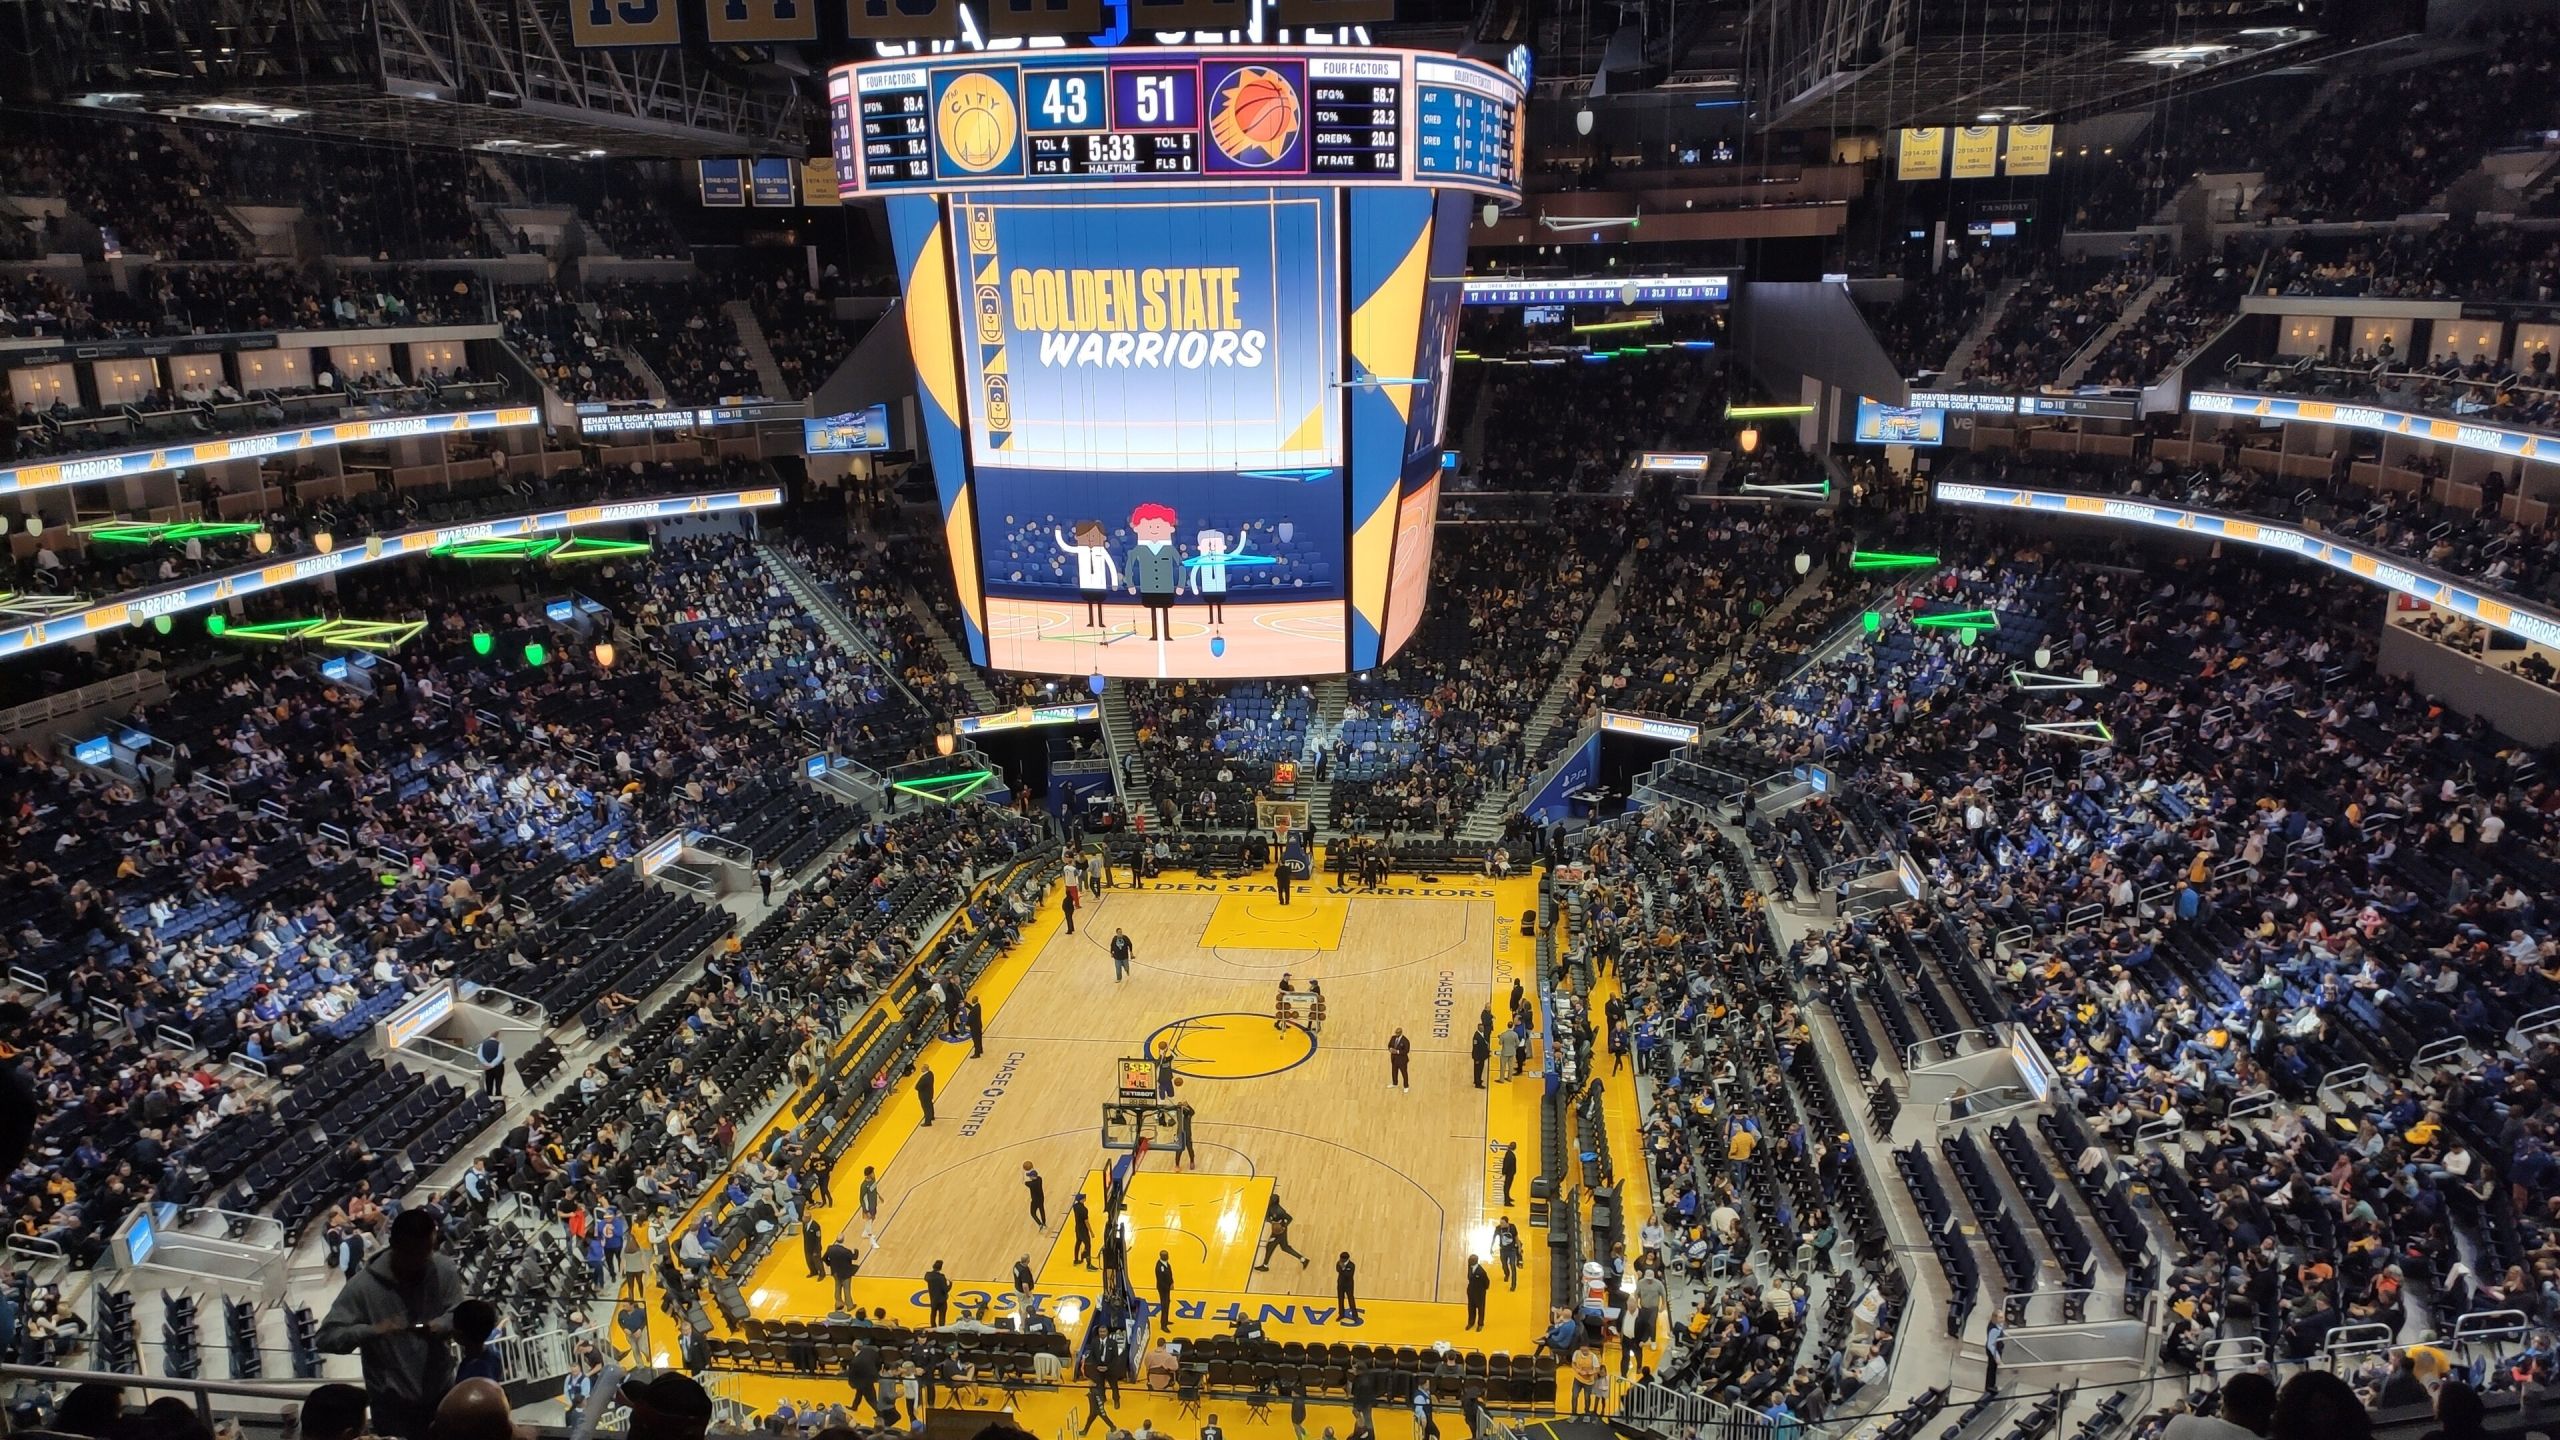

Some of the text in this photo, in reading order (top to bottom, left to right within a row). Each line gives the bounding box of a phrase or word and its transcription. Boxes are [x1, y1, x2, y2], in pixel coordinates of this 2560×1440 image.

[1323, 62, 1389, 76] FOUR FACTORS
[866, 73, 917, 88] FOUR FACTORS
[951, 92, 1000, 115] CITY
[1043, 77, 1087, 124] 43
[1137, 76, 1175, 121] 51
[1316, 90, 1344, 101] EFG%
[1424, 93, 1437, 103] AST
[1317, 109, 1395, 124] TO% 23.2
[866, 118, 926, 134] TO% 12.4
[908, 139, 927, 154] 15.4
[1036, 137, 1069, 151] TOL 4
[1155, 135, 1191, 149] TOL 5
[1317, 131, 1395, 147] OREB% 20.0
[1088, 134, 1135, 161] 5:33
[869, 161, 928, 176] FT RATE 12.8
[1037, 159, 1070, 173] FLS 0
[1088, 163, 1137, 174] HALFTIME
[1156, 156, 1191, 171] FLS 0
[1317, 153, 1395, 168] FT RATE 17.5
[1981, 203, 2030, 212] TANDUAY
[1010, 267, 1242, 332] GOLDEN STATE
[1471, 292, 1479, 301] 17
[1491, 292, 1497, 301] 4
[1588, 290, 1594, 299] 2
[1605, 290, 1615, 298] 24
[1039, 329, 1267, 370] WARRIORS
[1911, 393, 1949, 401] BEHAVIOR
[1949, 394, 1968, 402] SUCH
[1979, 395, 2004, 404] TRYING
[1911, 400, 1935, 408] ENTER
[1951, 402, 1976, 411] COURT,
[1977, 404, 2014, 412] THROWING
[582, 415, 621, 426] BEHAVIOR
[622, 414, 642, 423] SUCH
[644, 413, 654, 422] AS
[654, 412, 683, 421] TRYING
[683, 411, 693, 419] TO
[2335, 406, 2384, 427] WARRIORS
[370, 418, 428, 435] WARRIORS
[583, 418, 693, 433] ENTER THE COURT, THROWING
[2457, 427, 2502, 448] WARRIORS
[229, 436, 278, 456] WARRIORS
[61, 458, 123, 481] WARRIORS
[601, 503, 660, 520] WARRIORS
[2105, 502, 2156, 521] WARRIORS
[437, 524, 493, 544] WARRIORS
[2259, 528, 2304, 549] WARRIORS
[296, 554, 343, 576] WARRIORS
[2376, 564, 2416, 591] WARRIORS
[129, 592, 187, 617] WARRIORS
[1643, 722, 1690, 737] WARRIORS
[1571, 768, 1587, 782] PS4
[1226, 884, 1311, 894] STAE
[1326, 887, 1496, 898] WARRIORS
[1432, 971, 1454, 1038] CHASE CENTER
[957, 1051, 1026, 1138] CHASE CENTER
[1258, 1303, 1366, 1327] SAN
